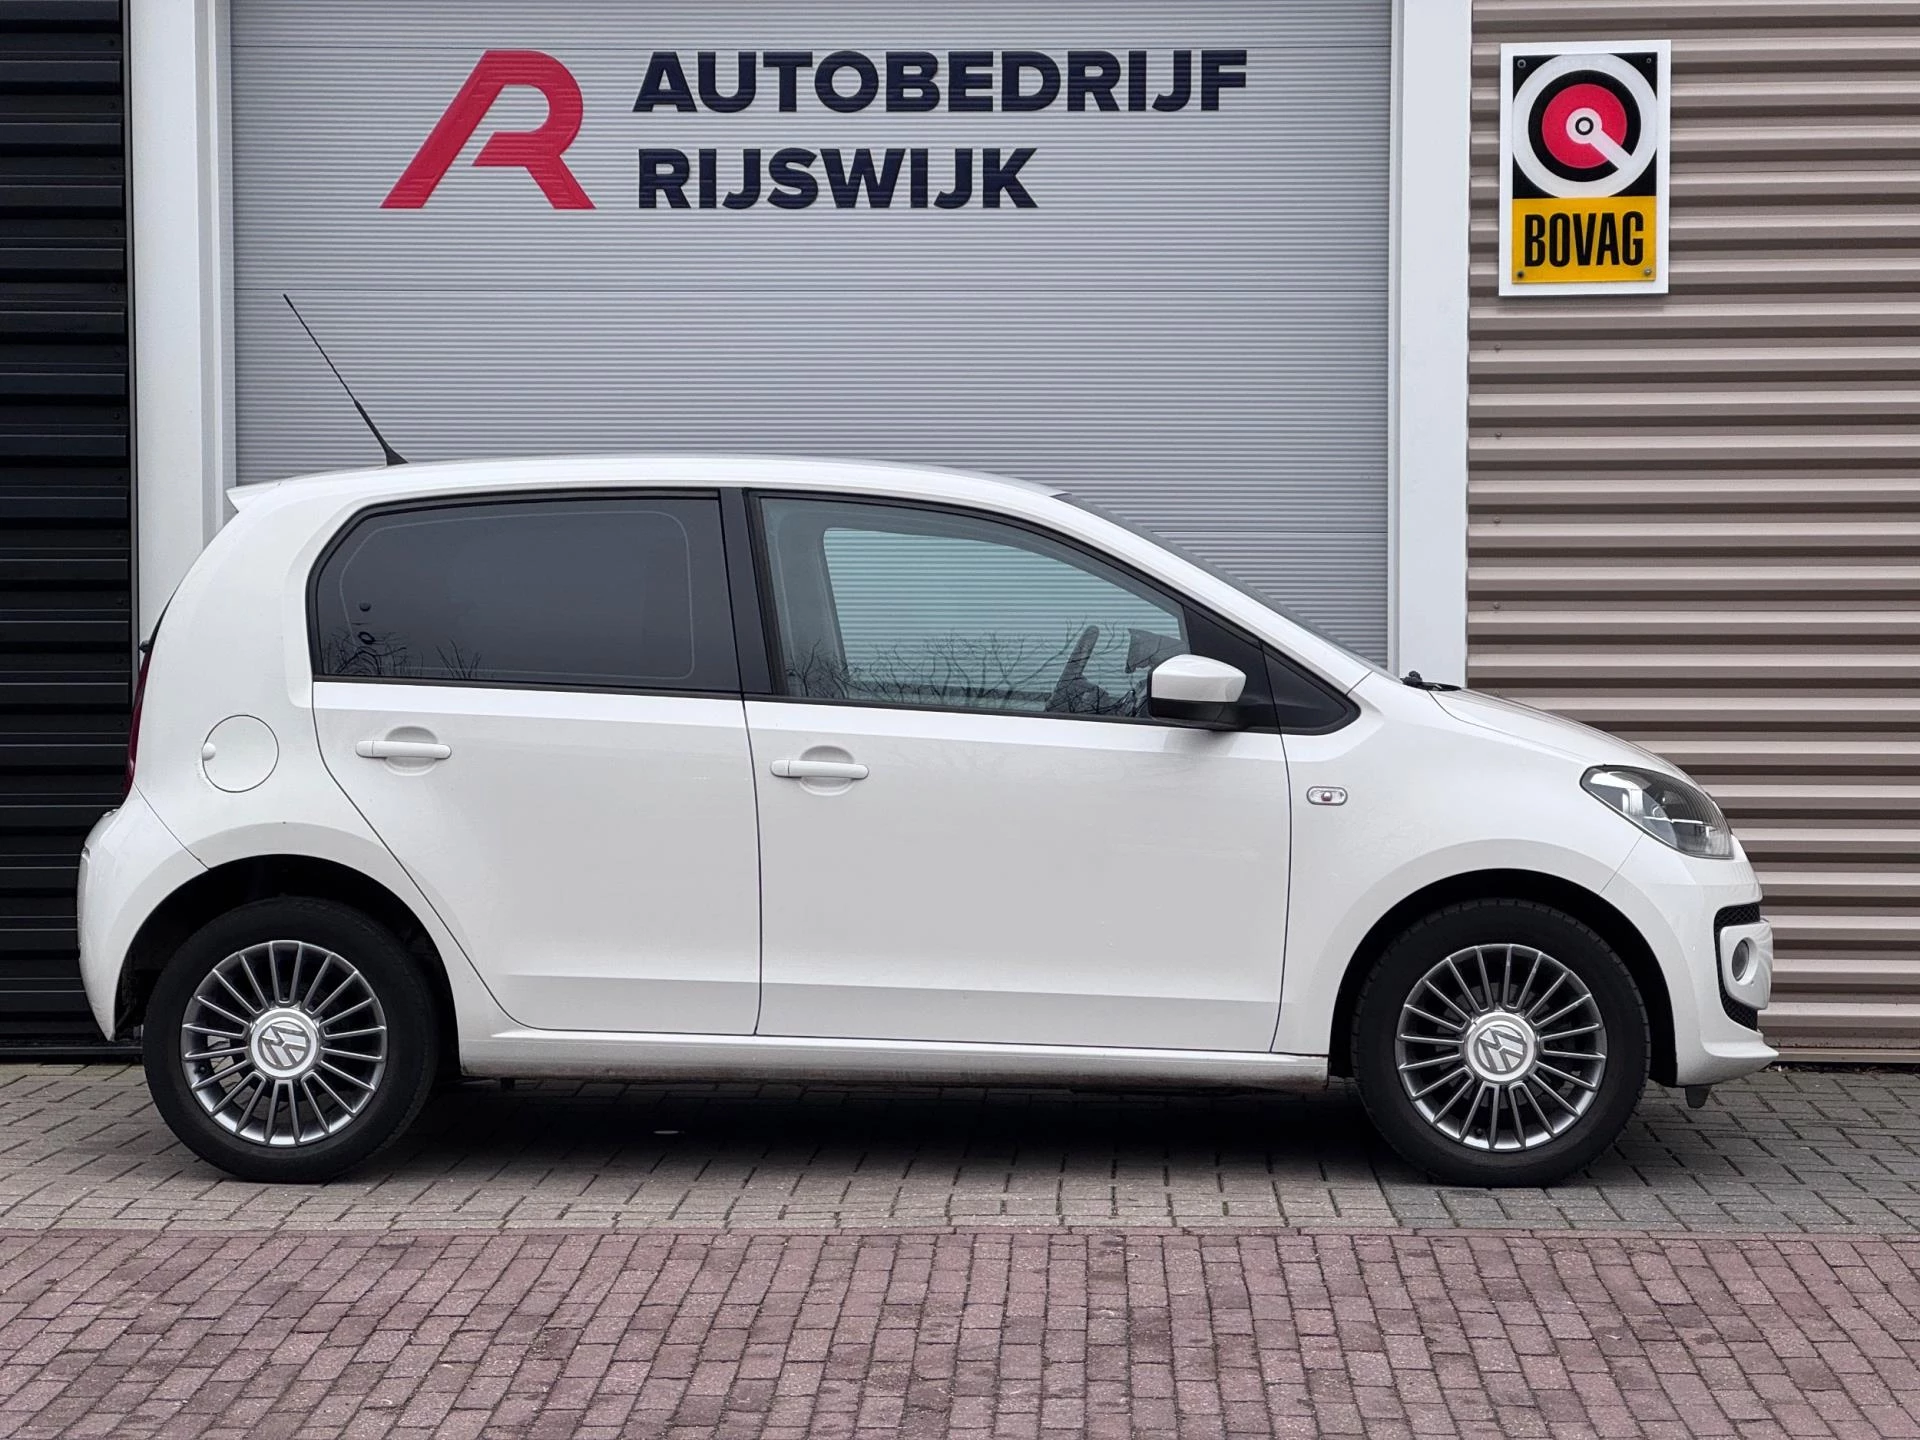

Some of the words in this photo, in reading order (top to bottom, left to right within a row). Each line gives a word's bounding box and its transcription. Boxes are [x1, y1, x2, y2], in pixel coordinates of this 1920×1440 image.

[633, 50, 1247, 113] AUTOBEDRIJF
[638, 148, 1038, 209] RIJSWIJK
[1524, 211, 1644, 268] BOVAG
